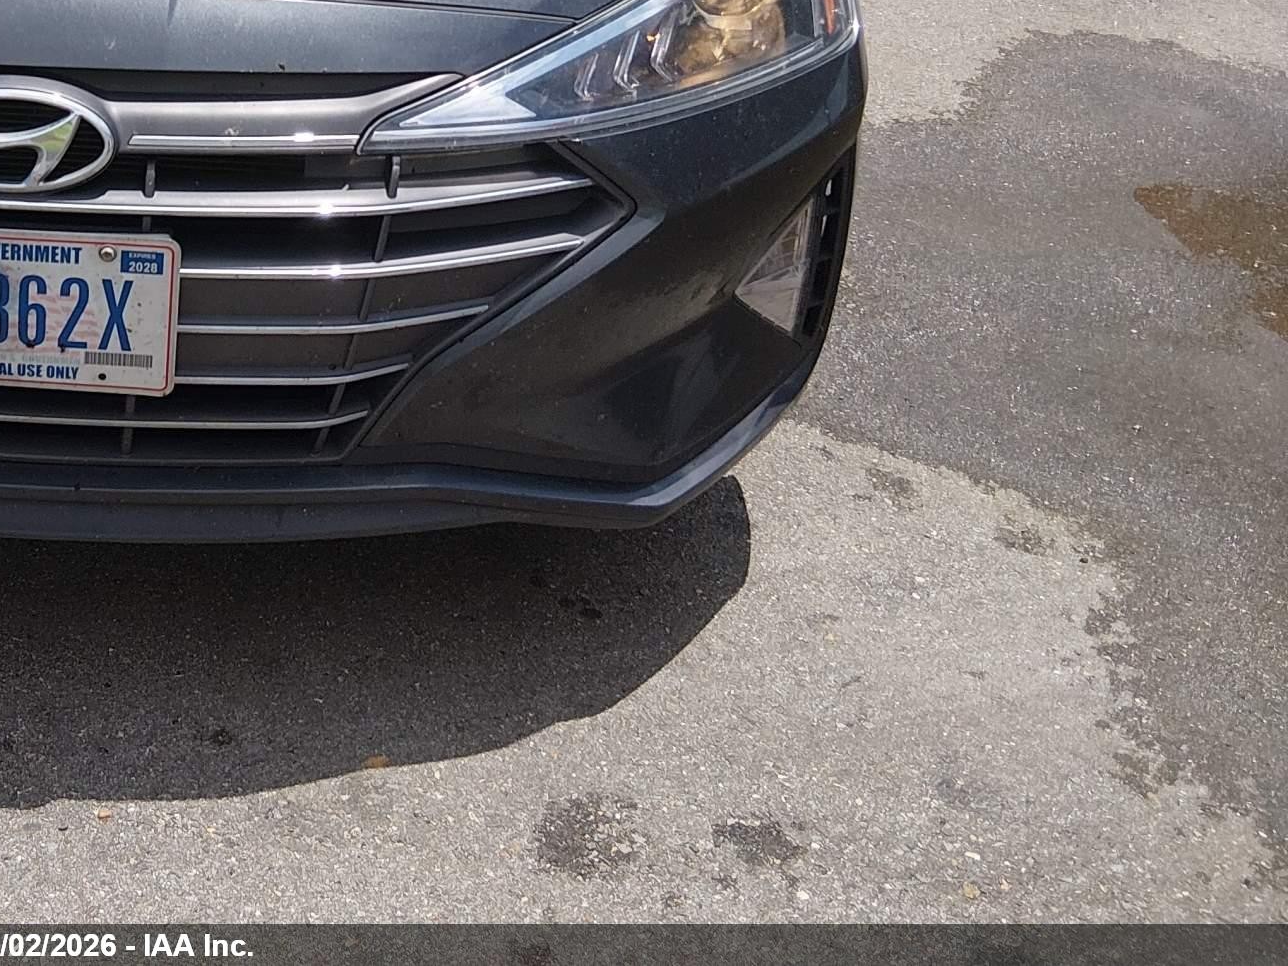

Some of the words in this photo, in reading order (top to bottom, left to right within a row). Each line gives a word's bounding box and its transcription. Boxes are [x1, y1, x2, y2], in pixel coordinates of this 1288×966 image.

[128, 261, 158, 274] 2028
[17, 363, 42, 378] USE
[46, 365, 79, 380] ONLY
